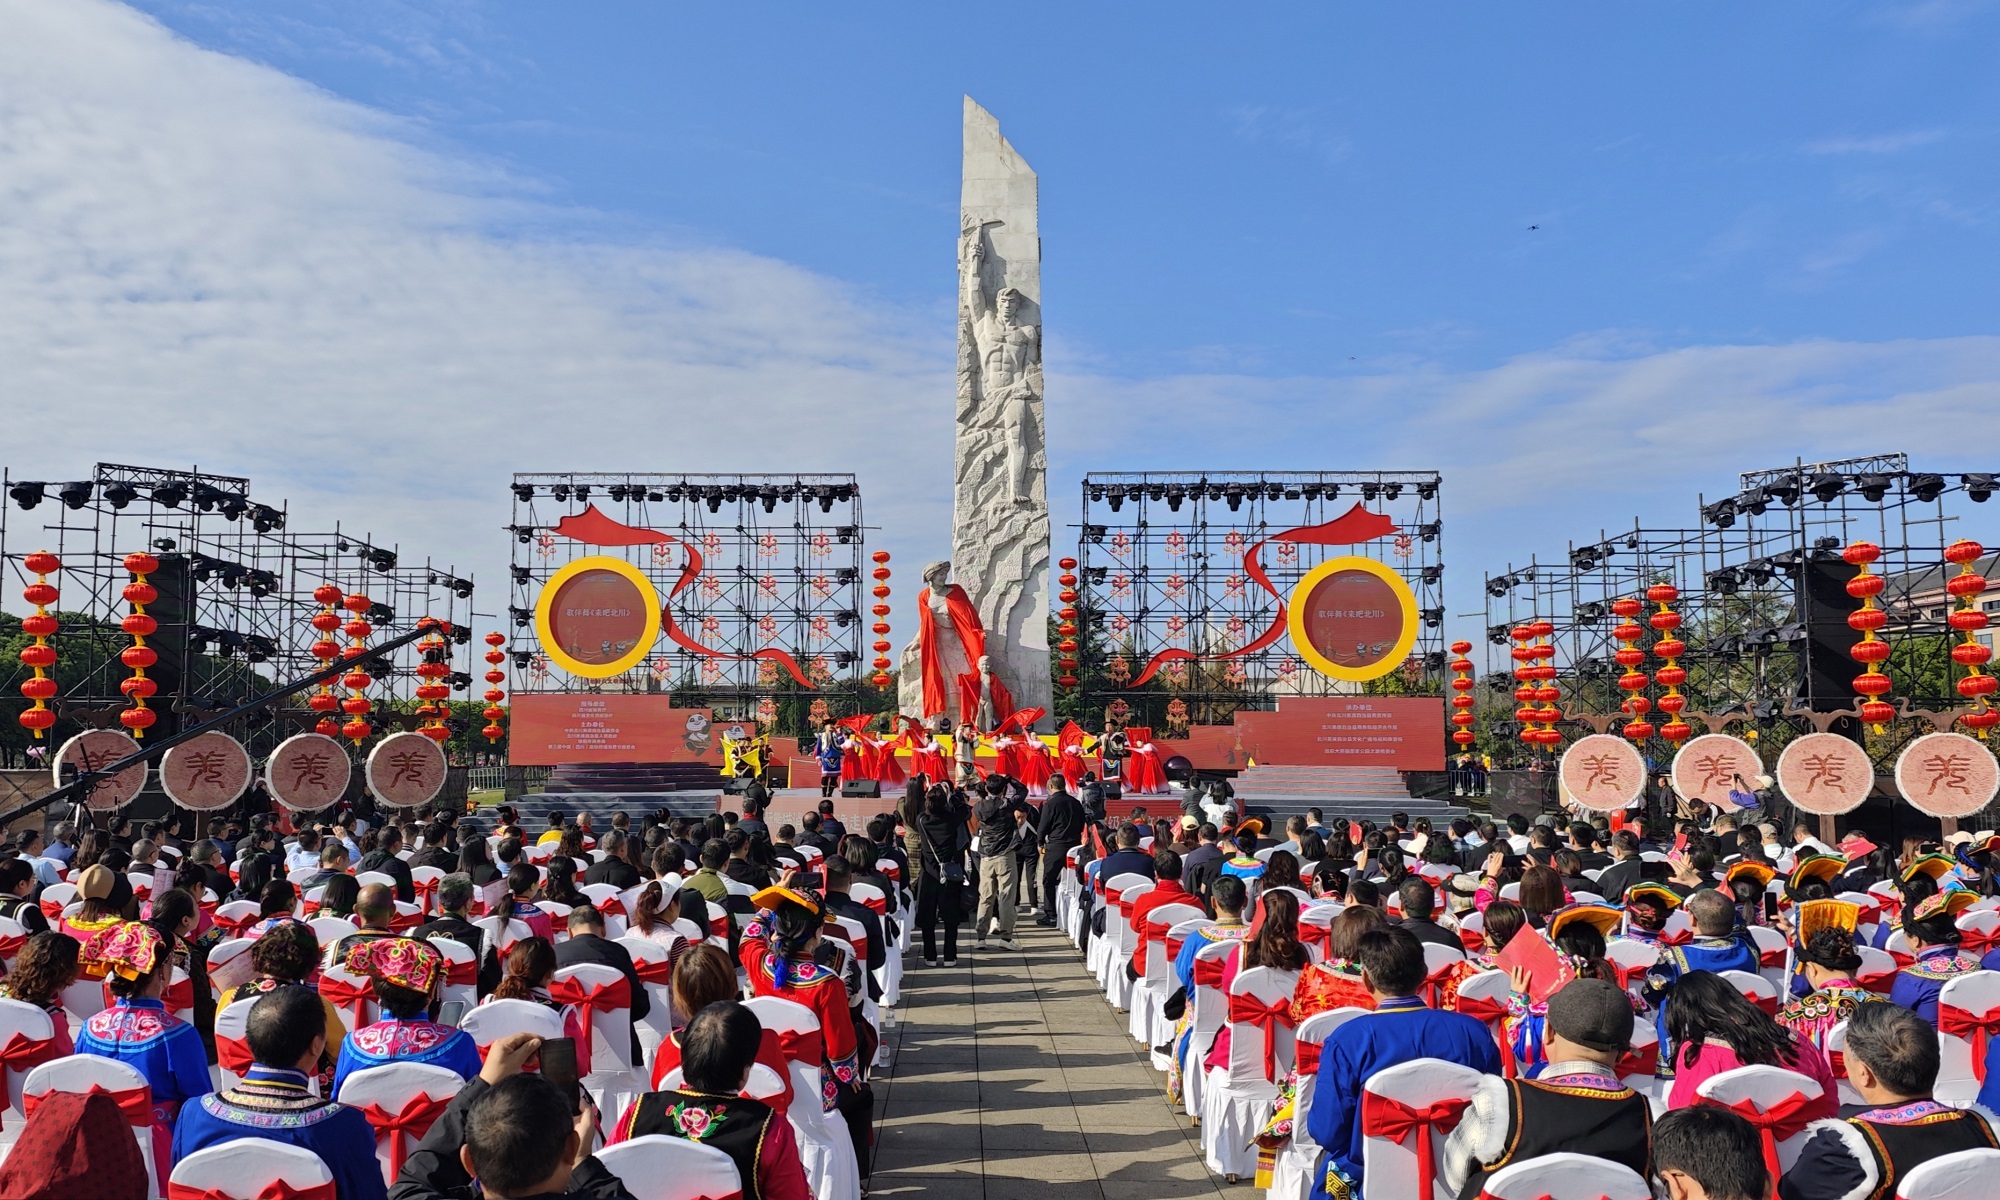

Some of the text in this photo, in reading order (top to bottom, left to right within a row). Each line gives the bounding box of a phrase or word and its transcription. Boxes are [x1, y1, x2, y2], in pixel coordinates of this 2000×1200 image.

[1318, 609, 1385, 618] 歌伴舞《来吧北川》
